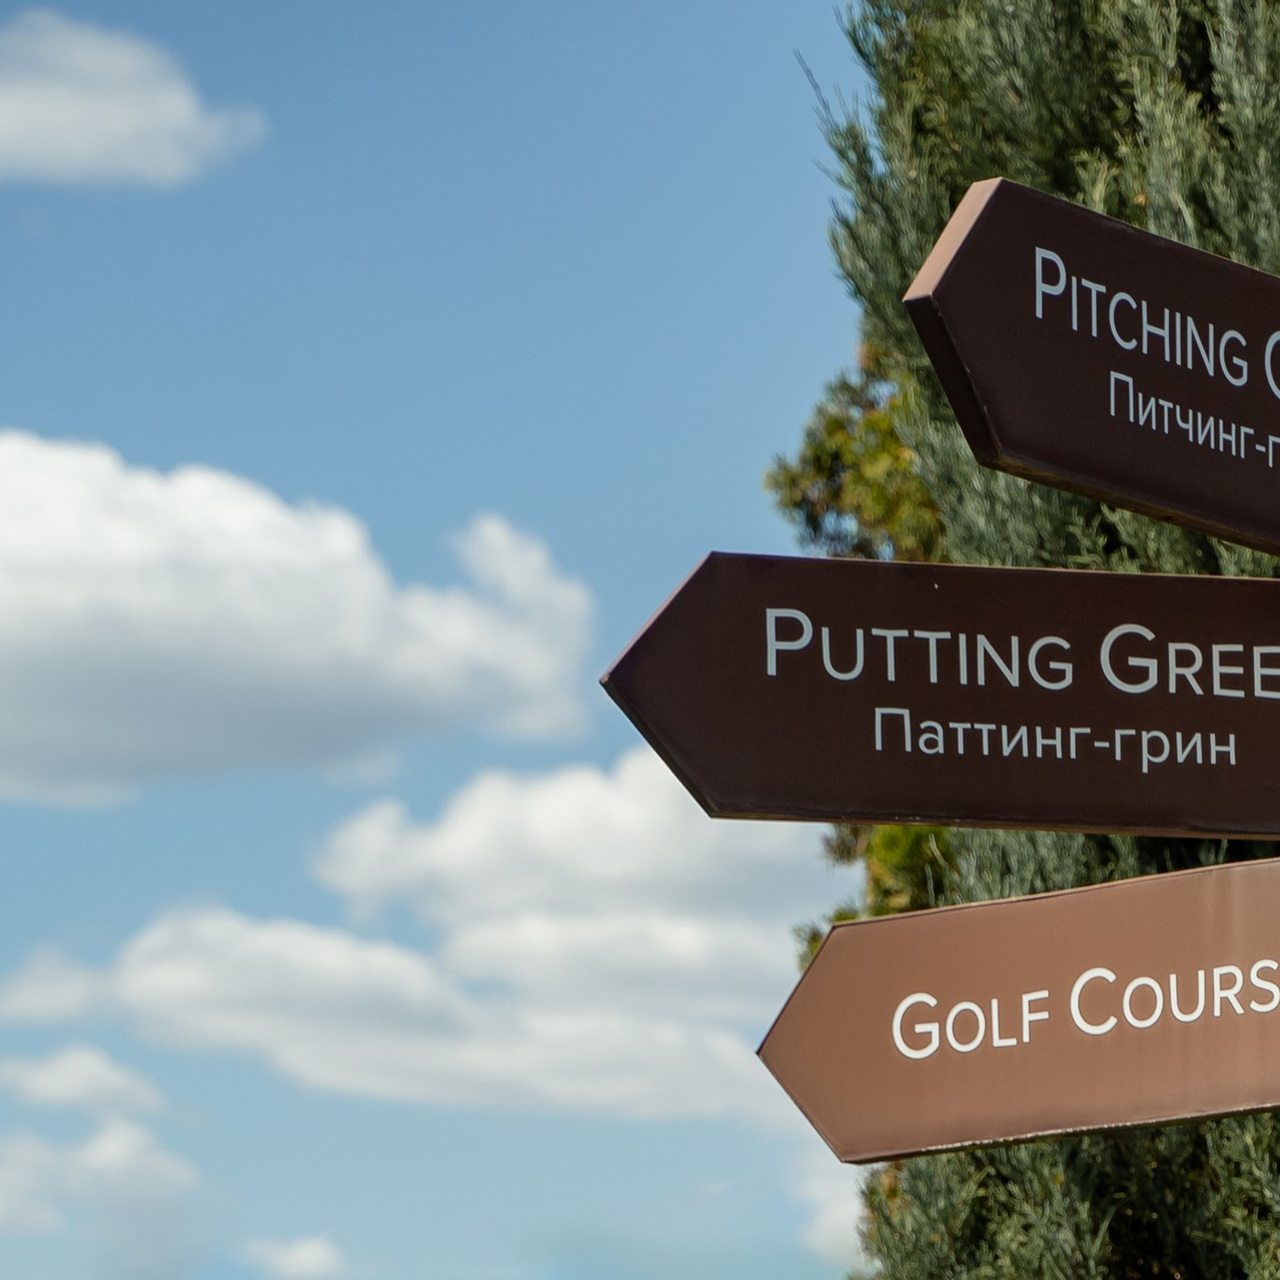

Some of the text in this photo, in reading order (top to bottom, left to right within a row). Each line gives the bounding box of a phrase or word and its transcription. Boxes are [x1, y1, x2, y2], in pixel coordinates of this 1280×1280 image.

[1035, 246, 1248, 386] PITCHING
[765, 607, 1073, 691] PUTTING
[874, 707, 1236, 773] Паттинг-грин
[892, 989, 1049, 1059] GOLF
